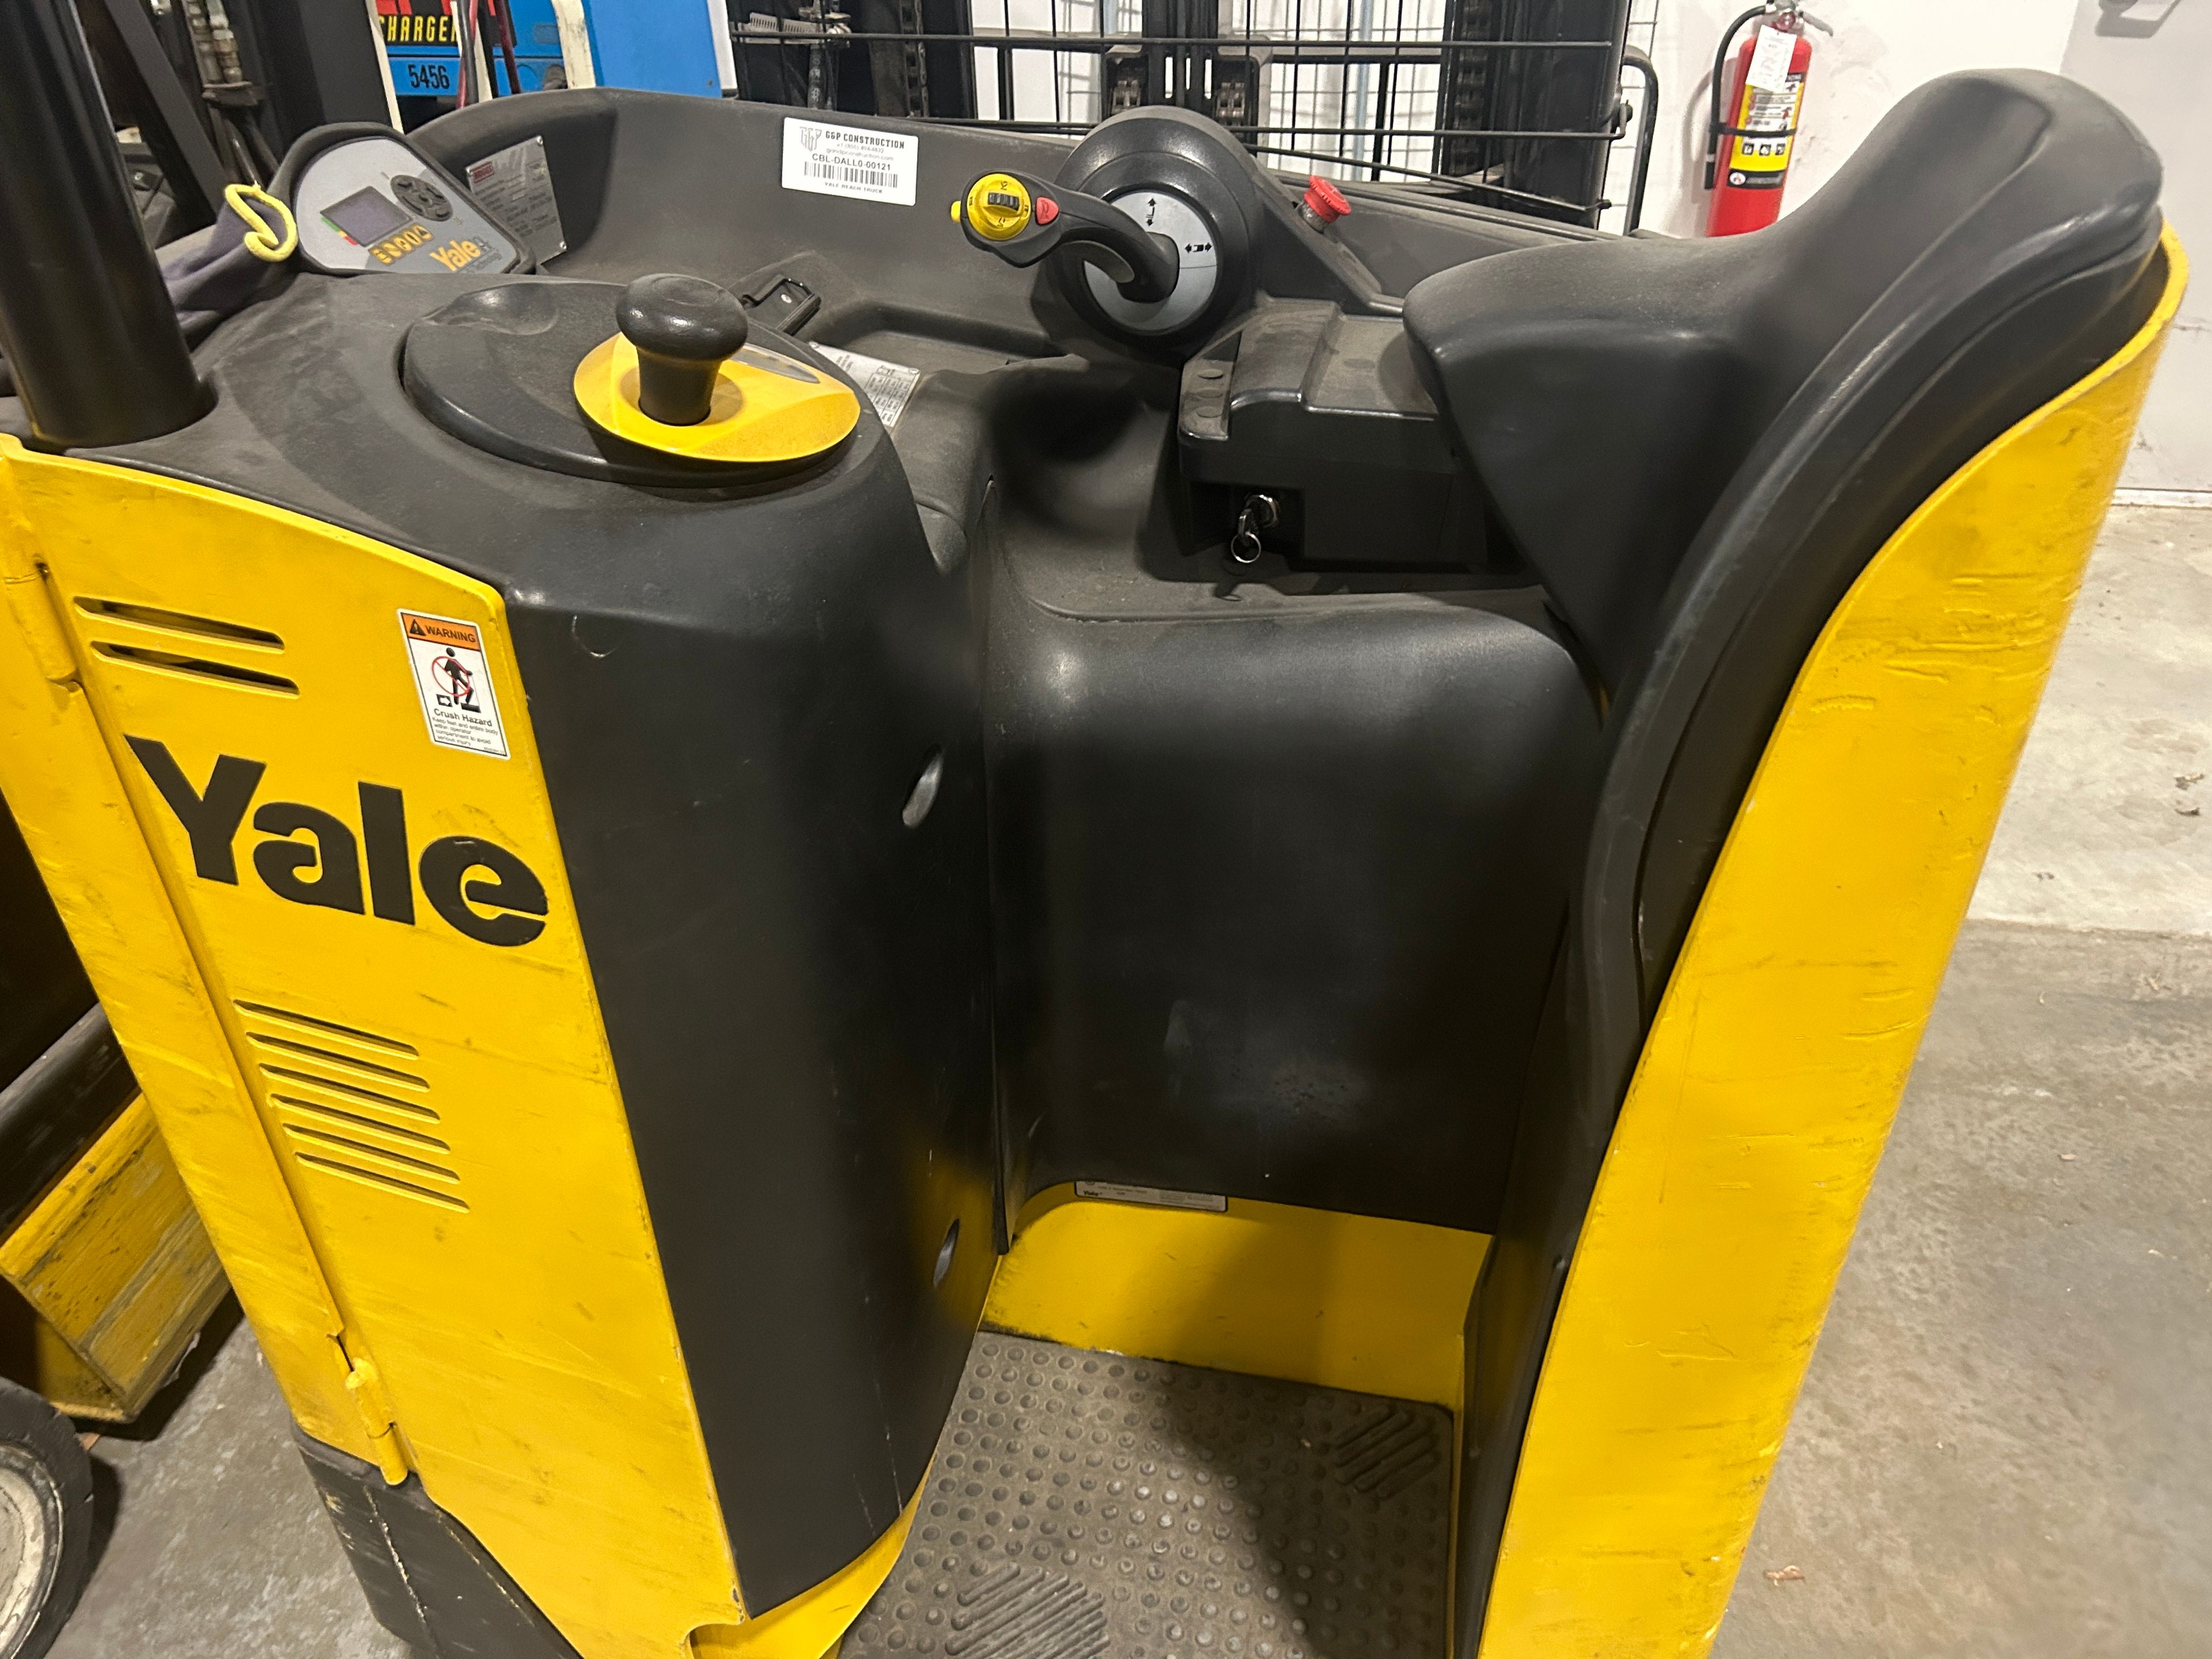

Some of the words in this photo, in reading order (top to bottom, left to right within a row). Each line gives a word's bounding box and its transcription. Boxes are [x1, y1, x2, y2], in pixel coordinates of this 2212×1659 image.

[407, 65, 450, 89] 5456
[825, 130, 841, 141] G&P
[843, 133, 905, 149] CONSTRUCTION
[429, 239, 481, 272] Yale
[425, 624, 476, 643] WARNING
[434, 708, 460, 720] Crush
[462, 714, 493, 727] Hazard
[123, 733, 550, 948] Yale
